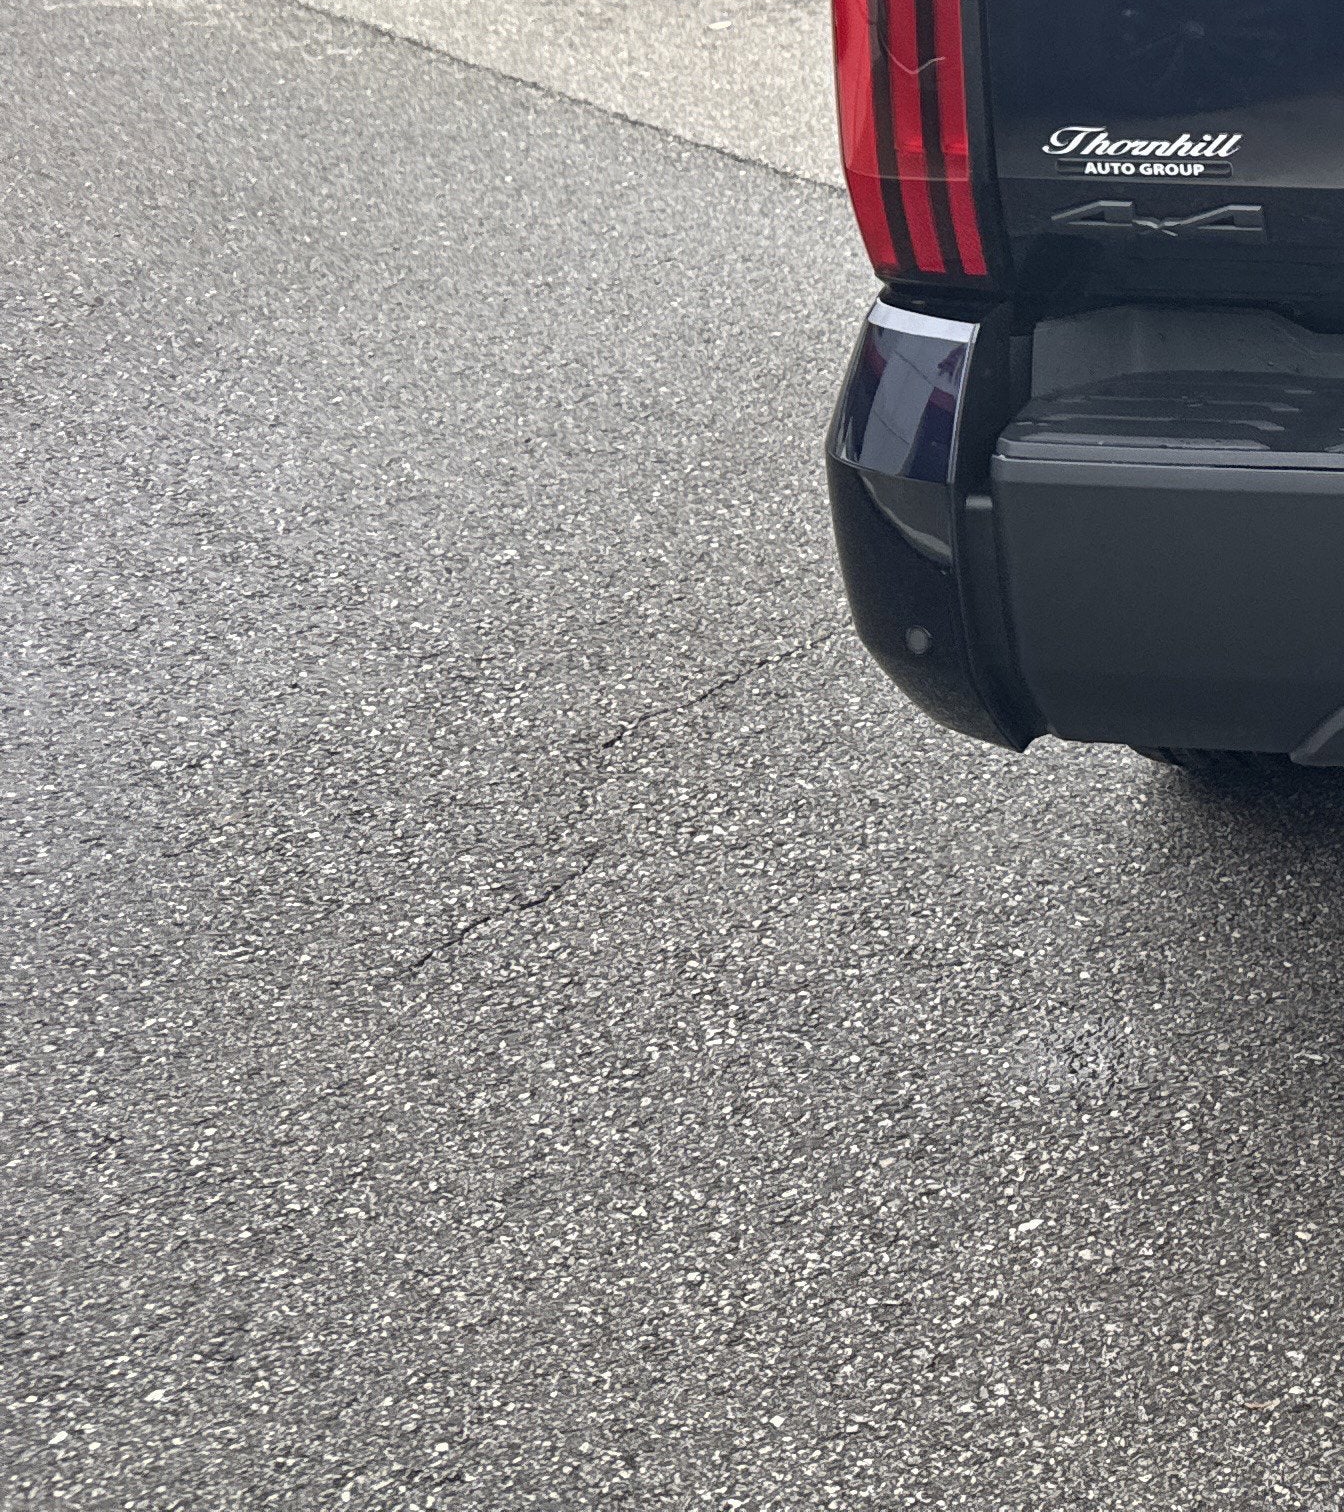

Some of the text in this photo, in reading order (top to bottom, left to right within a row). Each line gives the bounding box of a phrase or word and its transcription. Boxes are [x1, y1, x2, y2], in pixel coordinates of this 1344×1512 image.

[1041, 125, 1244, 158] Thornhill
[1084, 161, 1206, 177] AUTO GROUP
